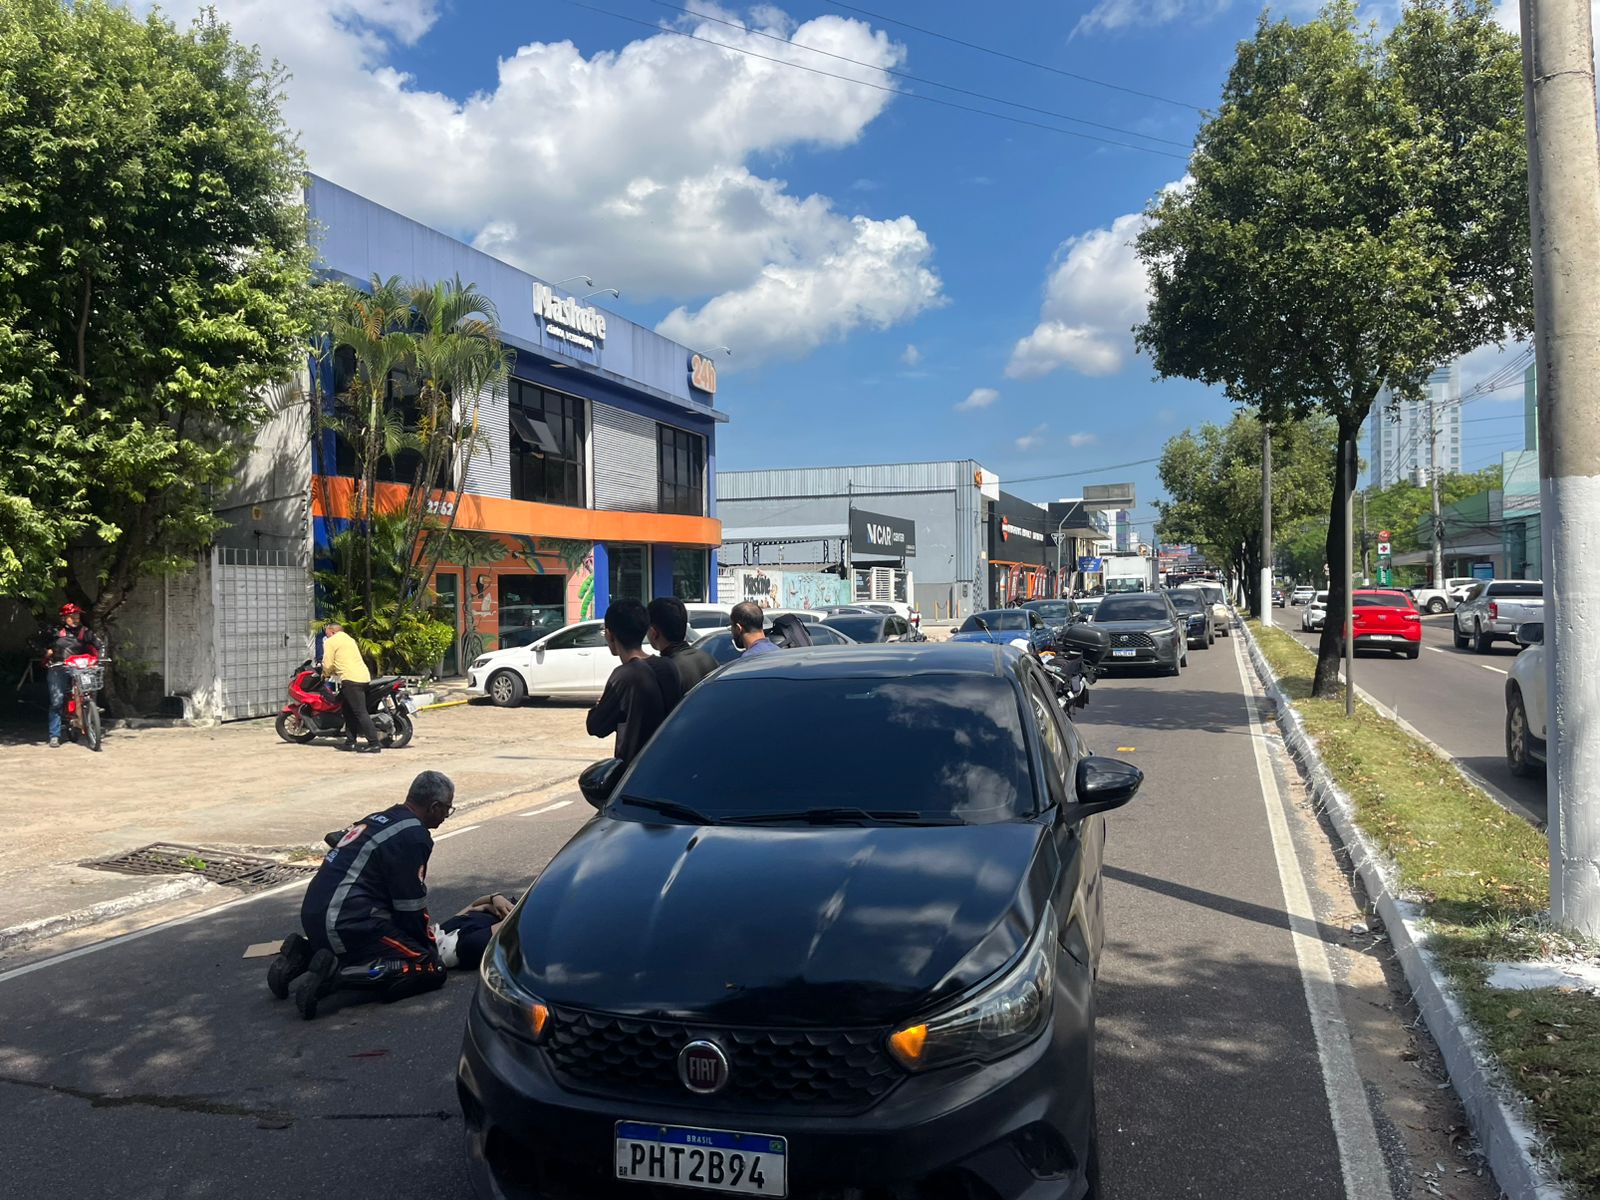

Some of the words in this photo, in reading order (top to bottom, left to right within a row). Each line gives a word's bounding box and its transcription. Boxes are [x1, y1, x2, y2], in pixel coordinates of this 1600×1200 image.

[692, 355, 716, 393] 24h
[689, 1056, 717, 1082] FIAT
[686, 1134, 713, 1145] BRASIL
[619, 1166, 628, 1177] BR
[630, 1142, 765, 1189] PHT2B94
